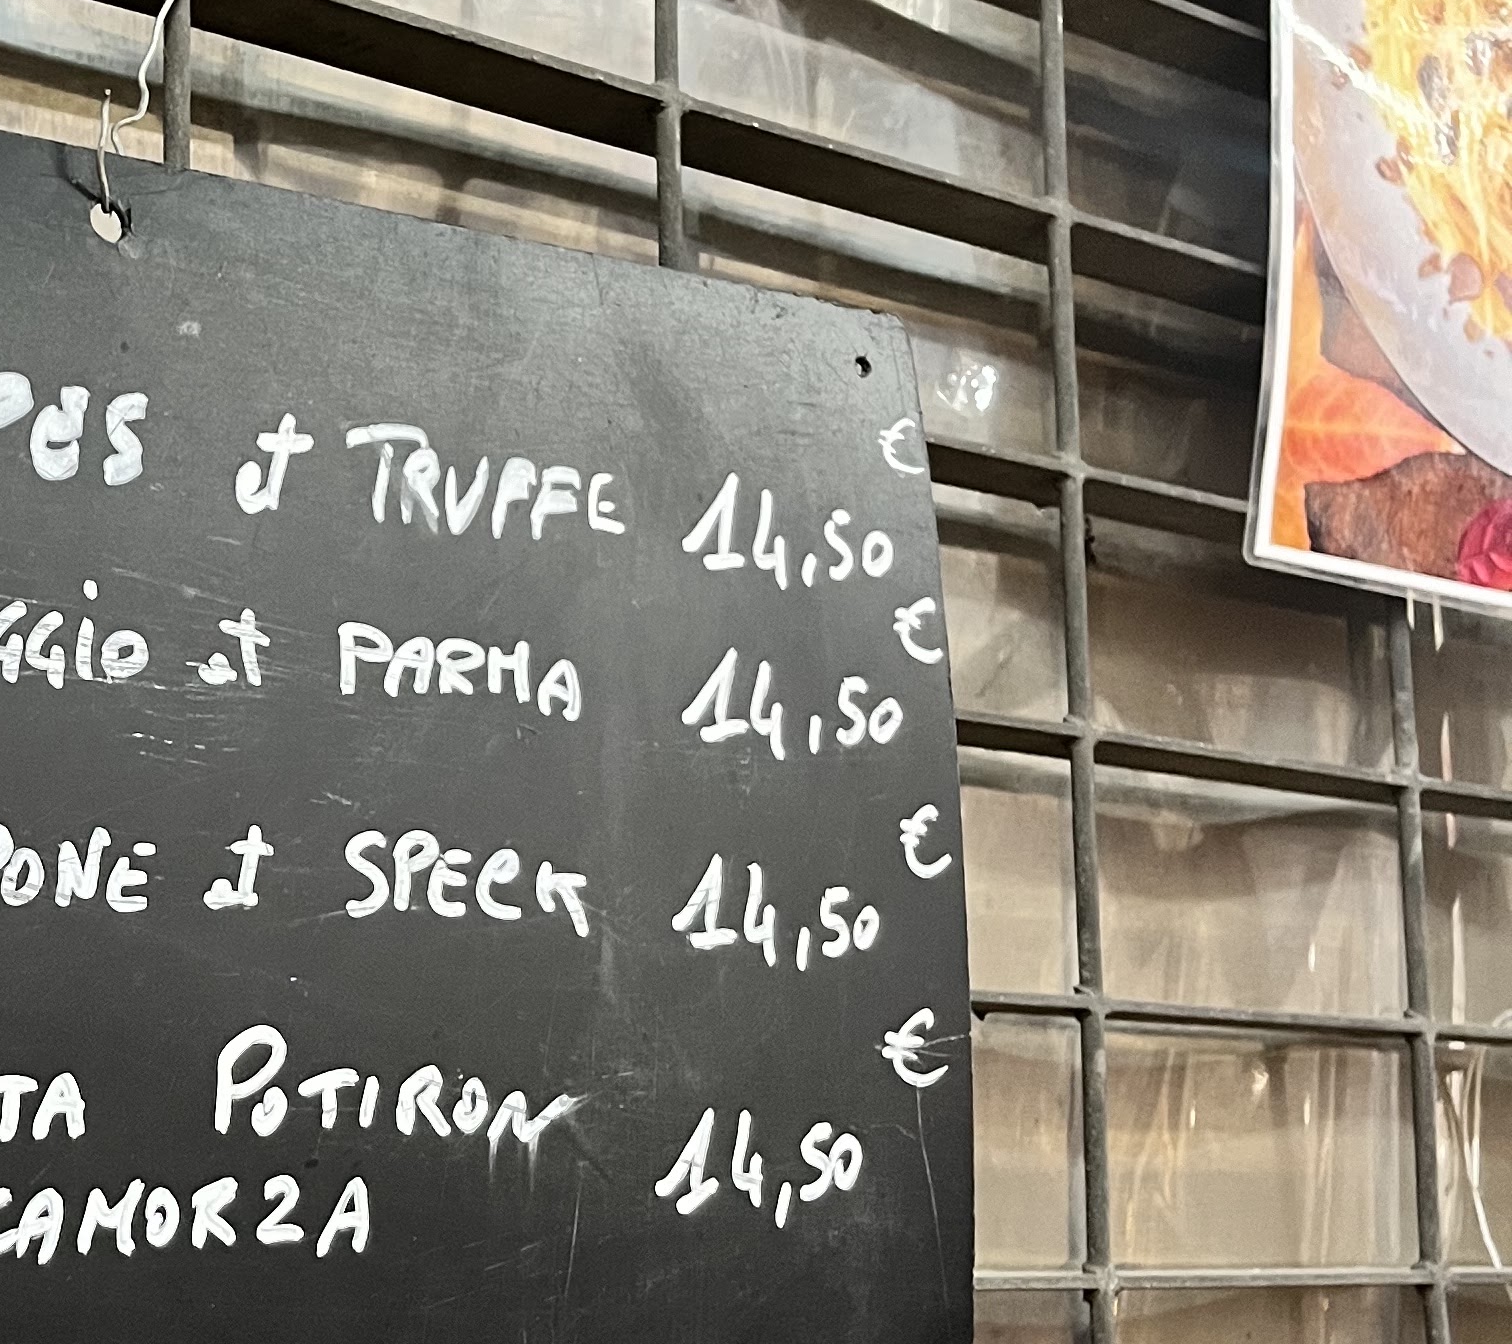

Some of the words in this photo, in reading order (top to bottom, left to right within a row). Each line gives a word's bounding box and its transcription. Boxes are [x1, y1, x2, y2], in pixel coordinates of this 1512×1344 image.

[346, 423, 626, 540] TRUFFE
[682, 472, 895, 591] 14,50
[338, 622, 582, 722] PARMA
[345, 830, 589, 937] SPECK
[672, 853, 881, 972] 14,50
[215, 1024, 582, 1156] POTIRON
[655, 1108, 864, 1229] 14,50
